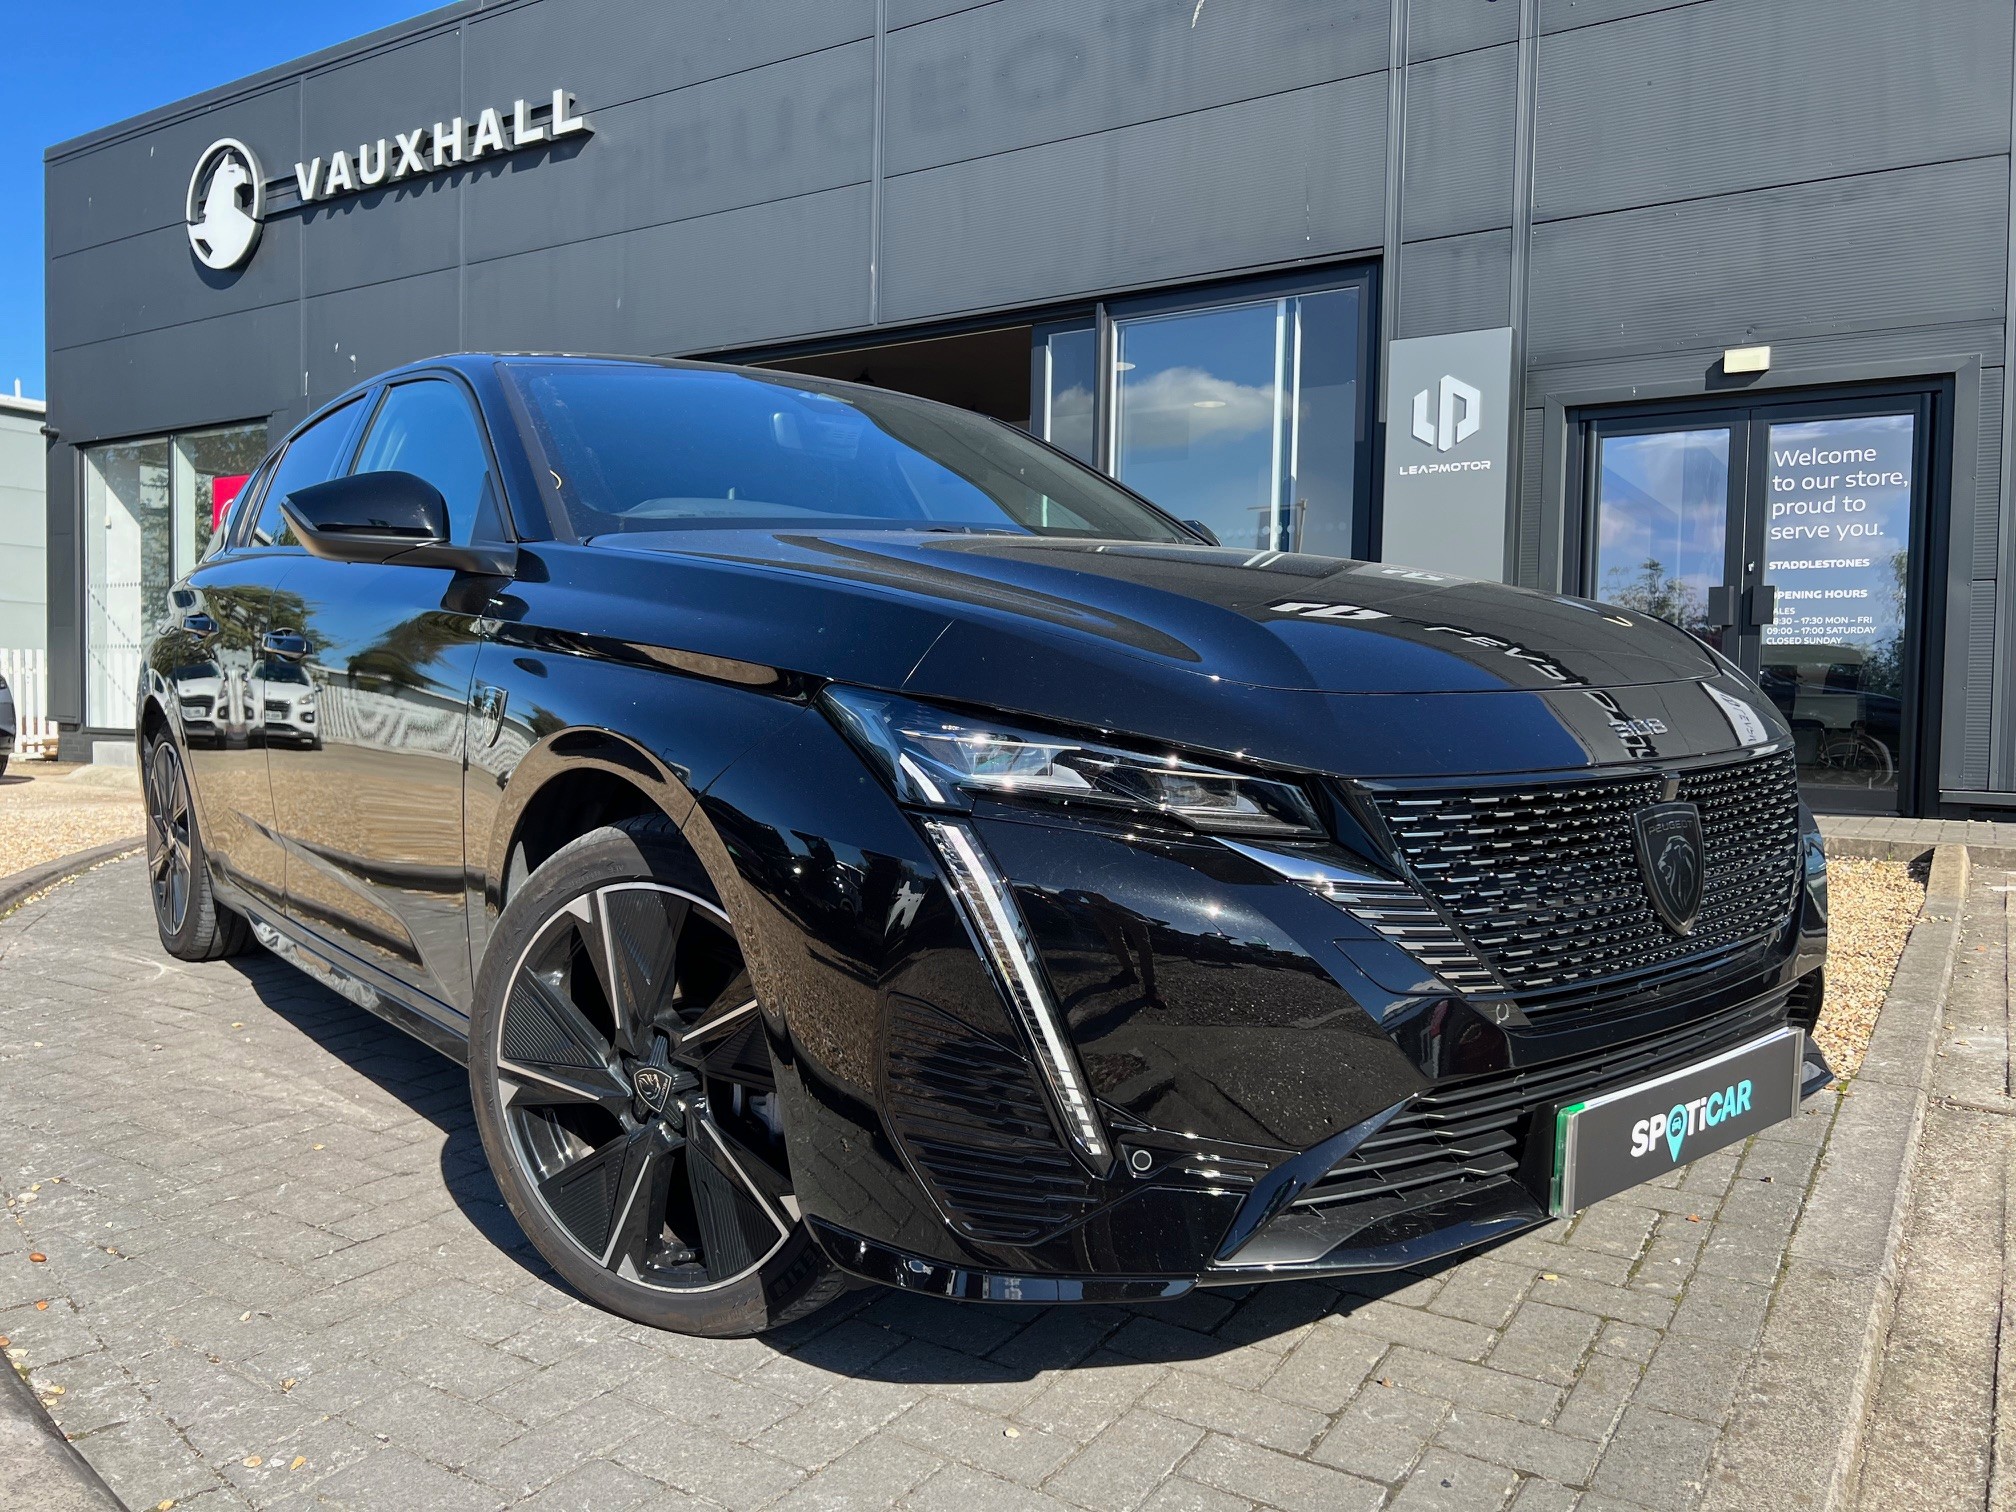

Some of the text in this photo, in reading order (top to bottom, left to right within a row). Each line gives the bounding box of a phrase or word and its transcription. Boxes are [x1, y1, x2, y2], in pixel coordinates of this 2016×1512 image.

[294, 88, 590, 202] VAUXHALL
[1774, 447, 1877, 467] Welcome
[1399, 460, 1492, 476] LEAPMOTOR
[1772, 470, 1909, 492] to our store,
[1772, 495, 1866, 520] proud to
[1770, 522, 1884, 541] serve you.
[1768, 558, 1871, 570] STADDLESTONES
[1824, 589, 1868, 599] HOURS
[1773, 607, 1796, 615] ALES
[1773, 617, 1793, 625] 8:30
[1801, 616, 1823, 625] 17:30
[1825, 616, 1848, 624] MON
[1857, 616, 1873, 624] FRI
[1766, 627, 1793, 635] 09:00
[1801, 626, 1824, 635] 17:00
[1825, 626, 1877, 635] SATURDAY
[1766, 636, 1843, 645] CLOSED SUNDAY
[1608, 717, 1669, 739] 308
[1648, 820, 1692, 835] PEUGEOT
